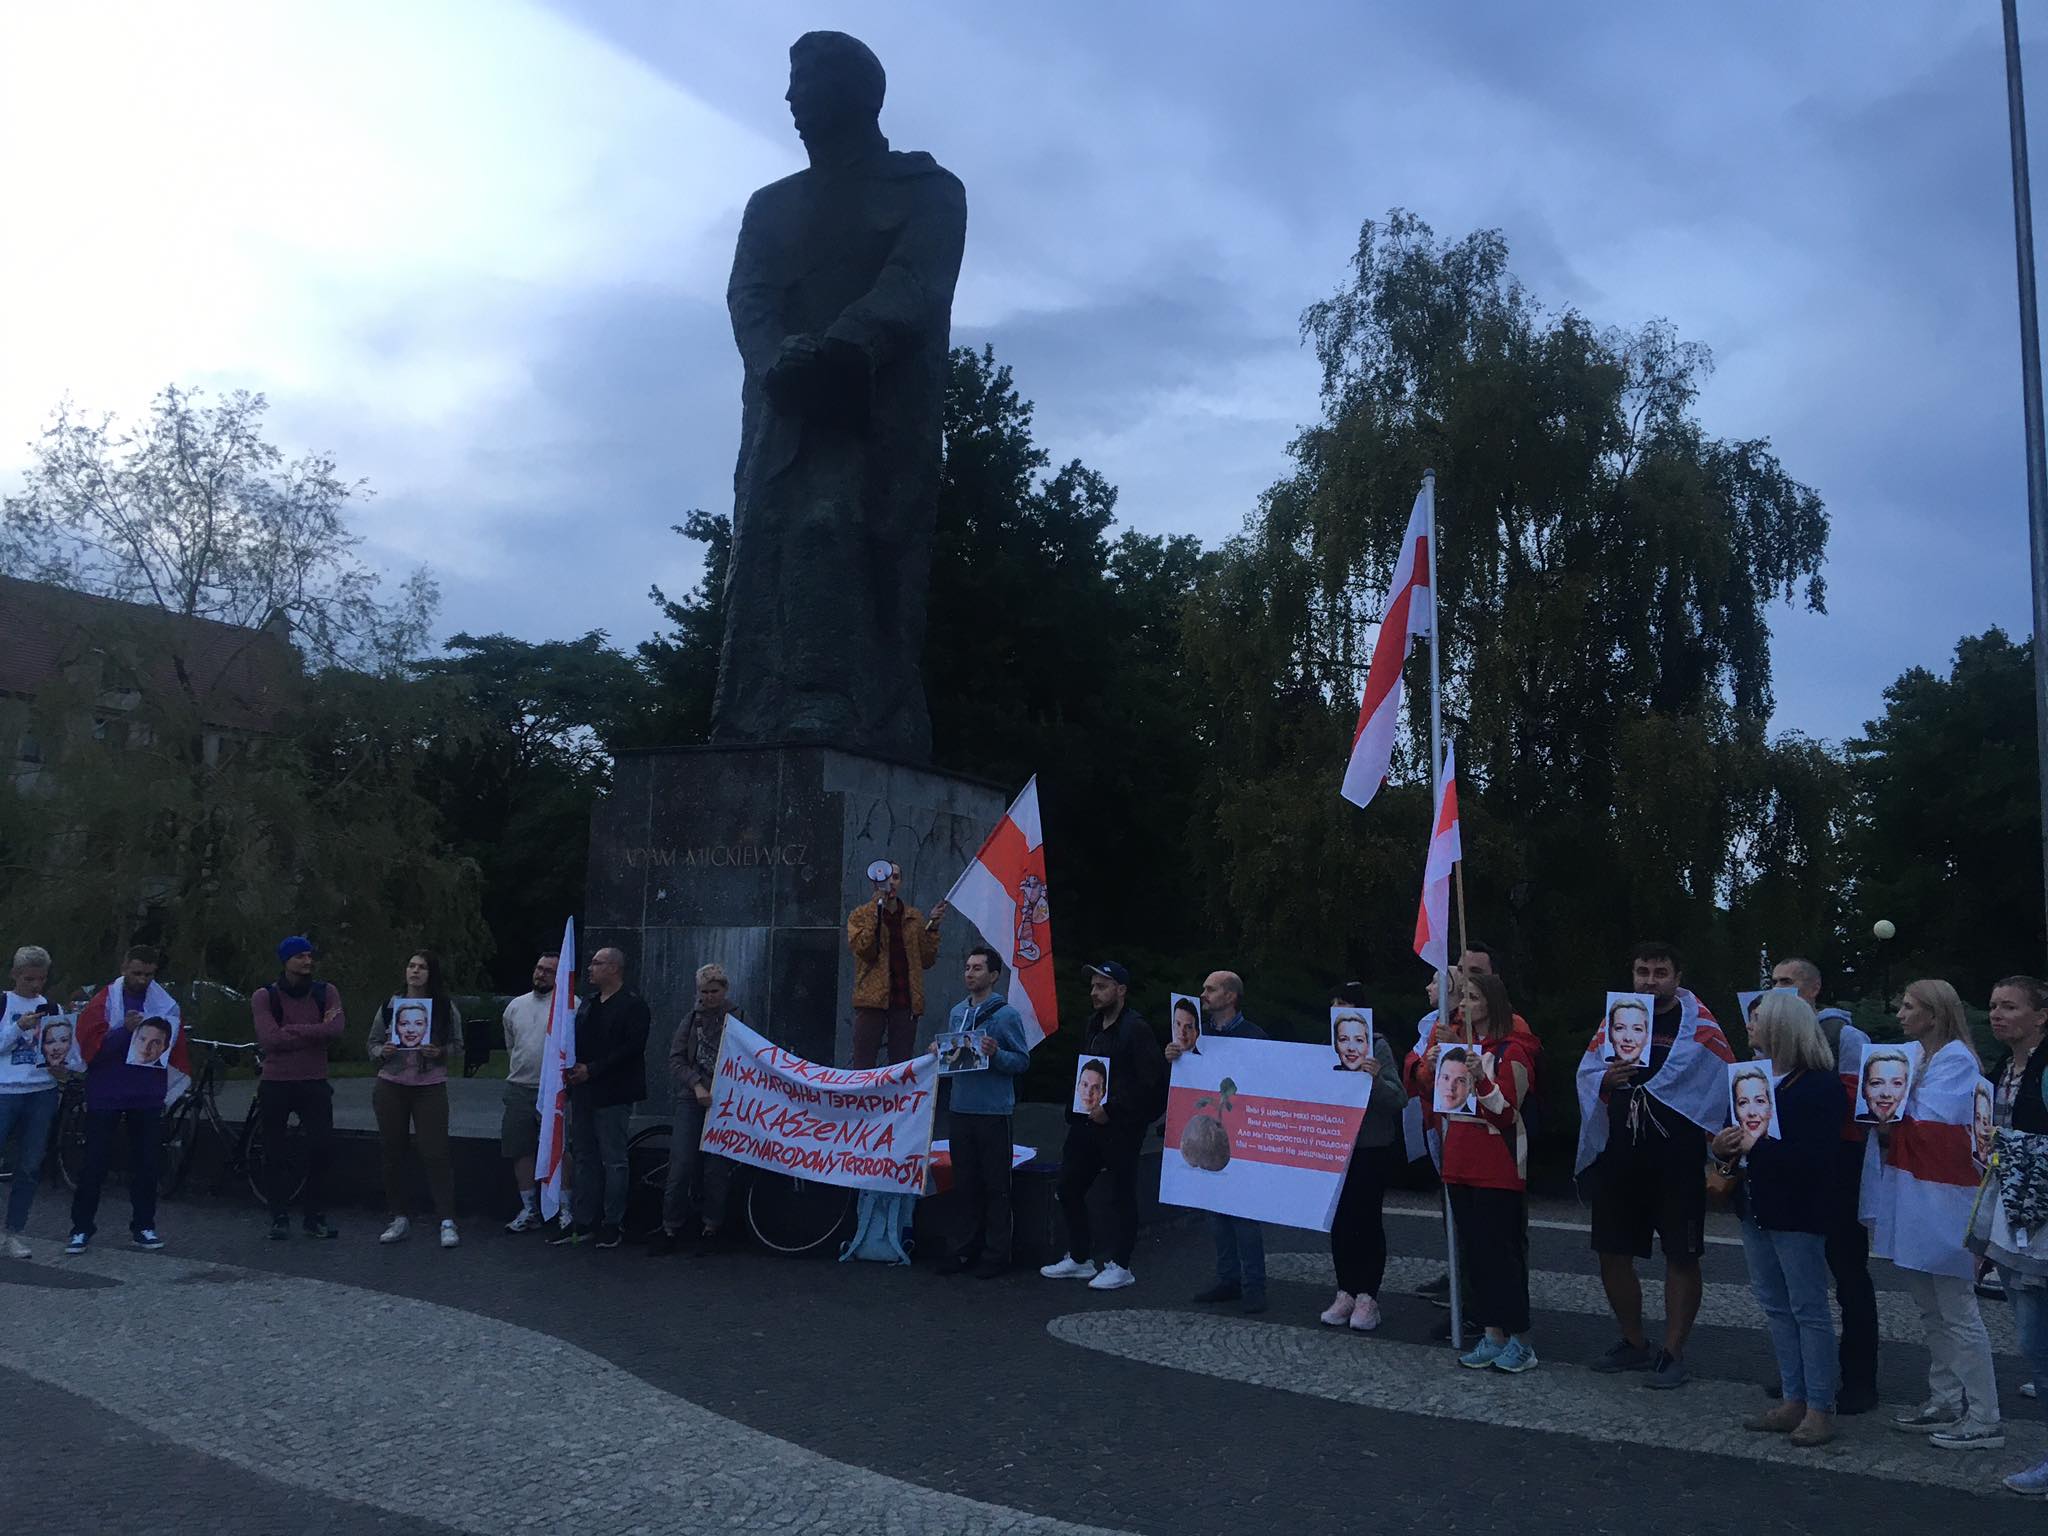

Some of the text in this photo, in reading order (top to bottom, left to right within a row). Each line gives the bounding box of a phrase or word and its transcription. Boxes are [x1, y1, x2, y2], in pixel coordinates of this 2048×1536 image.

[686, 844, 808, 866] MICKIEWICZ
[755, 1045, 917, 1088] ЛУКАШЭНКА
[823, 1090, 928, 1114] ТЭРАРЫСТ
[1237, 1128, 1252, 1137] Але
[1262, 1120, 1288, 1130] думалі
[1298, 1125, 1315, 1134] гэта
